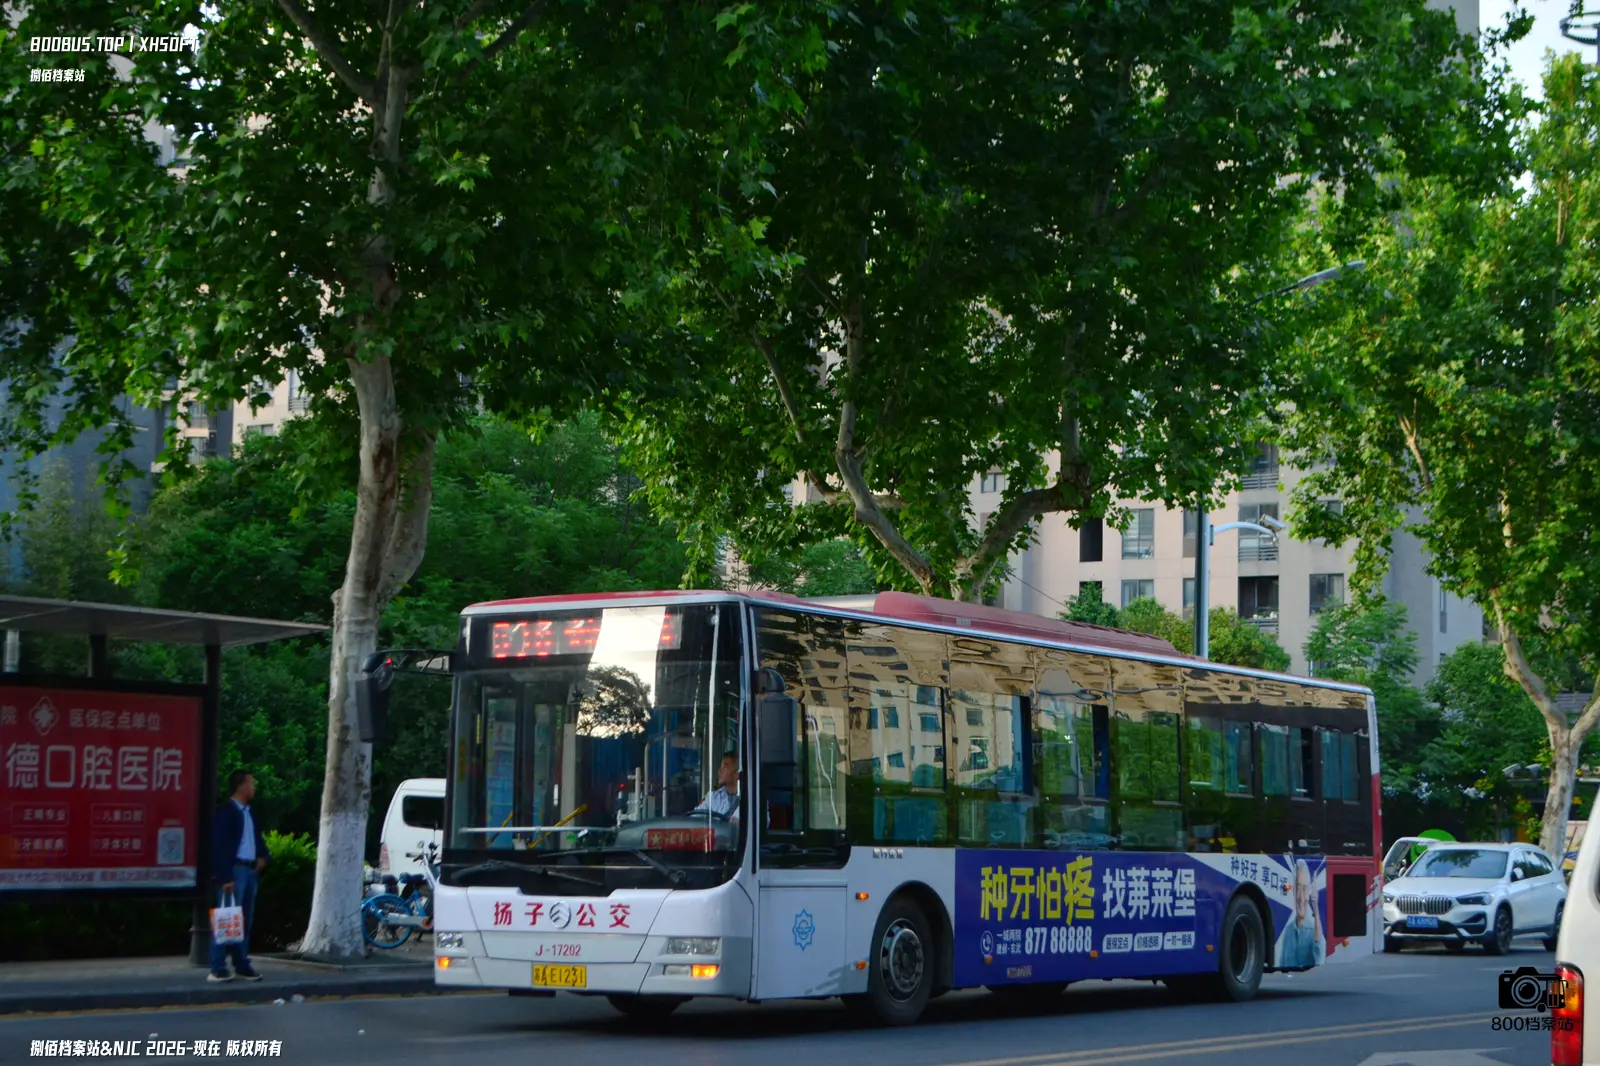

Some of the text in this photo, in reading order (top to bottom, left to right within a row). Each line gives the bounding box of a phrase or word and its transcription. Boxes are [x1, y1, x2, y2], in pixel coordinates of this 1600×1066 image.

[69, 709, 162, 731] 医保定点单位
[5, 742, 184, 792] 德口腔医院
[1231, 856, 1258, 881] 种好牙
[980, 855, 1095, 926] 种牙怕疼
[493, 901, 632, 930] 扬子公交
[535, 943, 582, 957] J-17202
[1025, 925, 1092, 955] 877 88888
